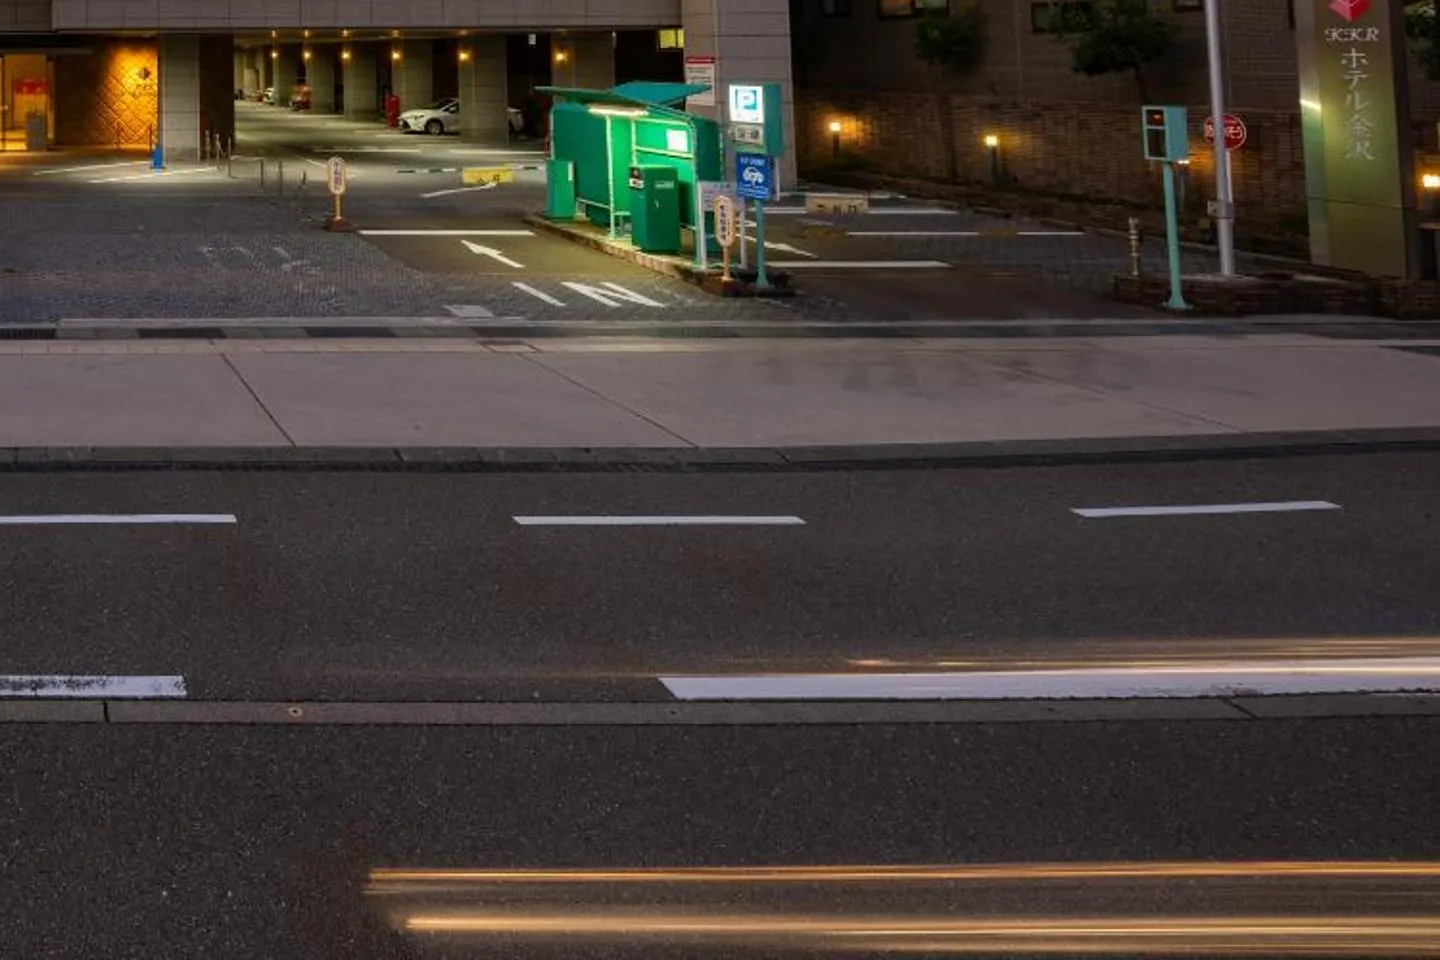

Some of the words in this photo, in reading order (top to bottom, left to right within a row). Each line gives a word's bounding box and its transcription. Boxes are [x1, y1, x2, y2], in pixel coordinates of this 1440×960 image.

[1341, 47, 1375, 160] ホテル金沢
